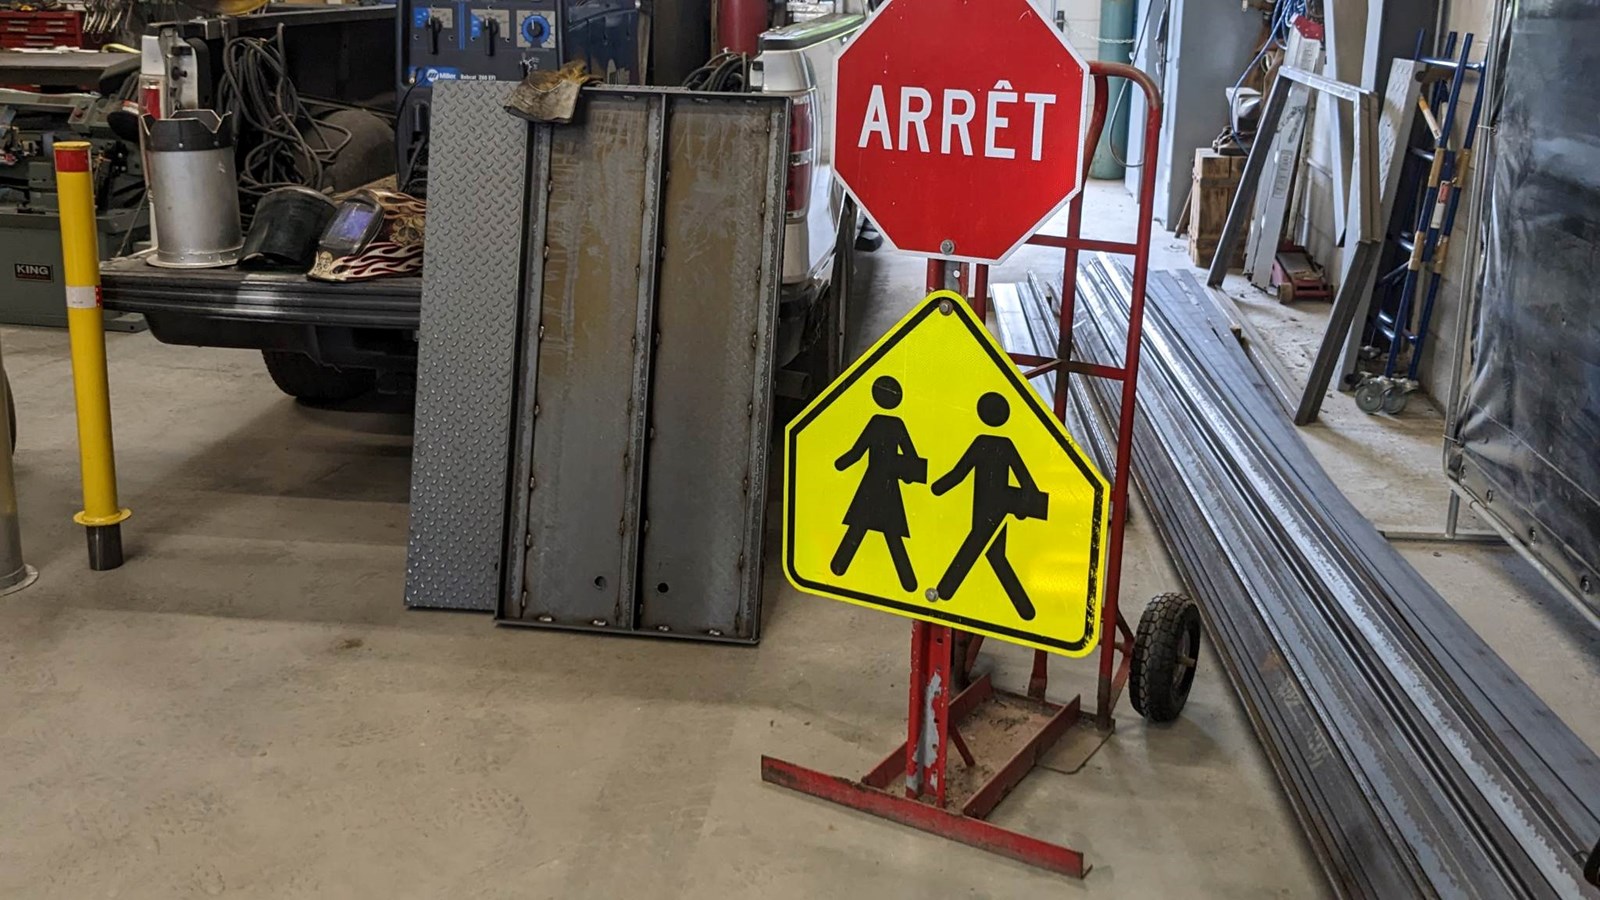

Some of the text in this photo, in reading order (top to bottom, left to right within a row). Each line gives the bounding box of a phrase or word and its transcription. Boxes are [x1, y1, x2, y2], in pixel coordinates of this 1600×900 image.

[440, 72, 456, 80] Miller
[858, 80, 1057, 162] ARRÊT
[16, 264, 49, 275] KING
